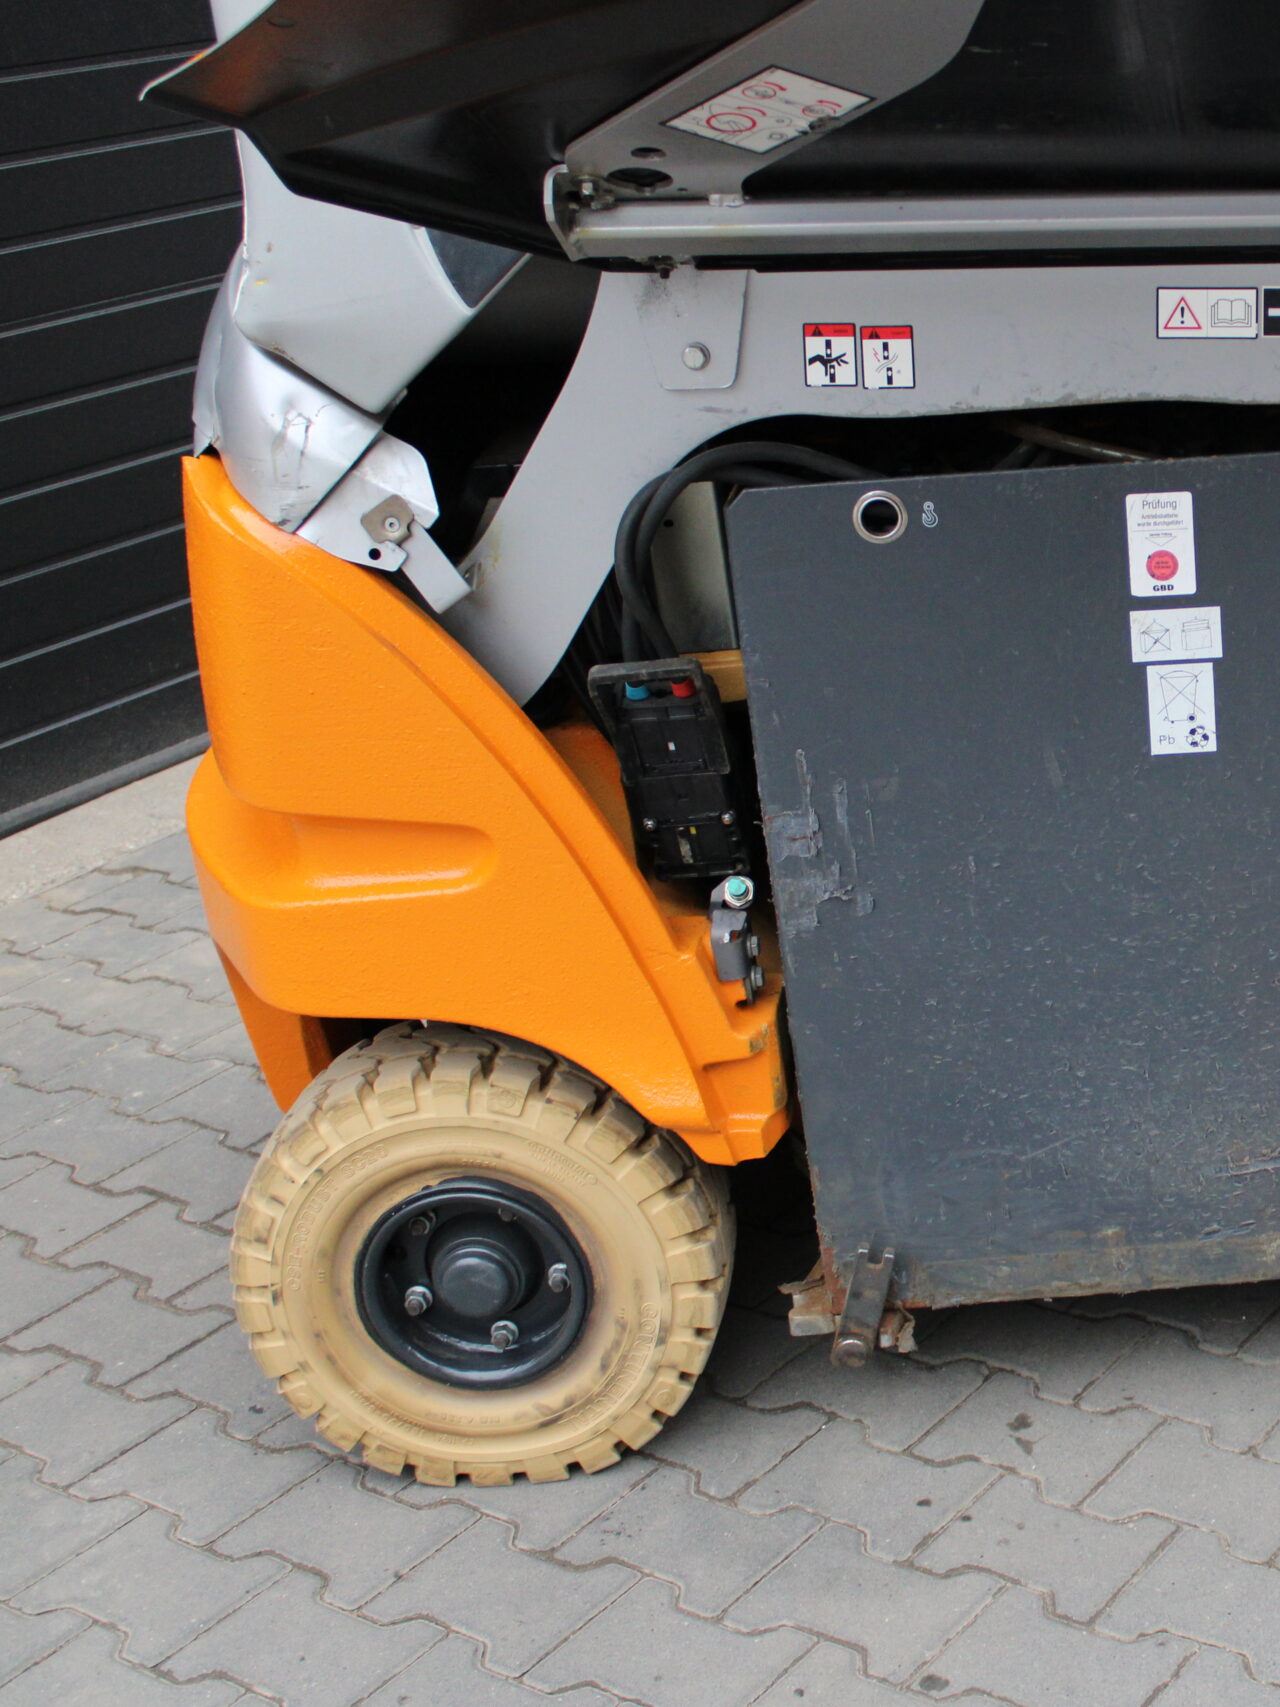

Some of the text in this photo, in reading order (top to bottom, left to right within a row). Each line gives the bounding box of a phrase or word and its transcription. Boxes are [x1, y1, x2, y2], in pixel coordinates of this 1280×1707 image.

[1142, 499, 1177, 510] Prüfung
[1152, 584, 1175, 592] GBD
[1159, 734, 1176, 745] Pb
